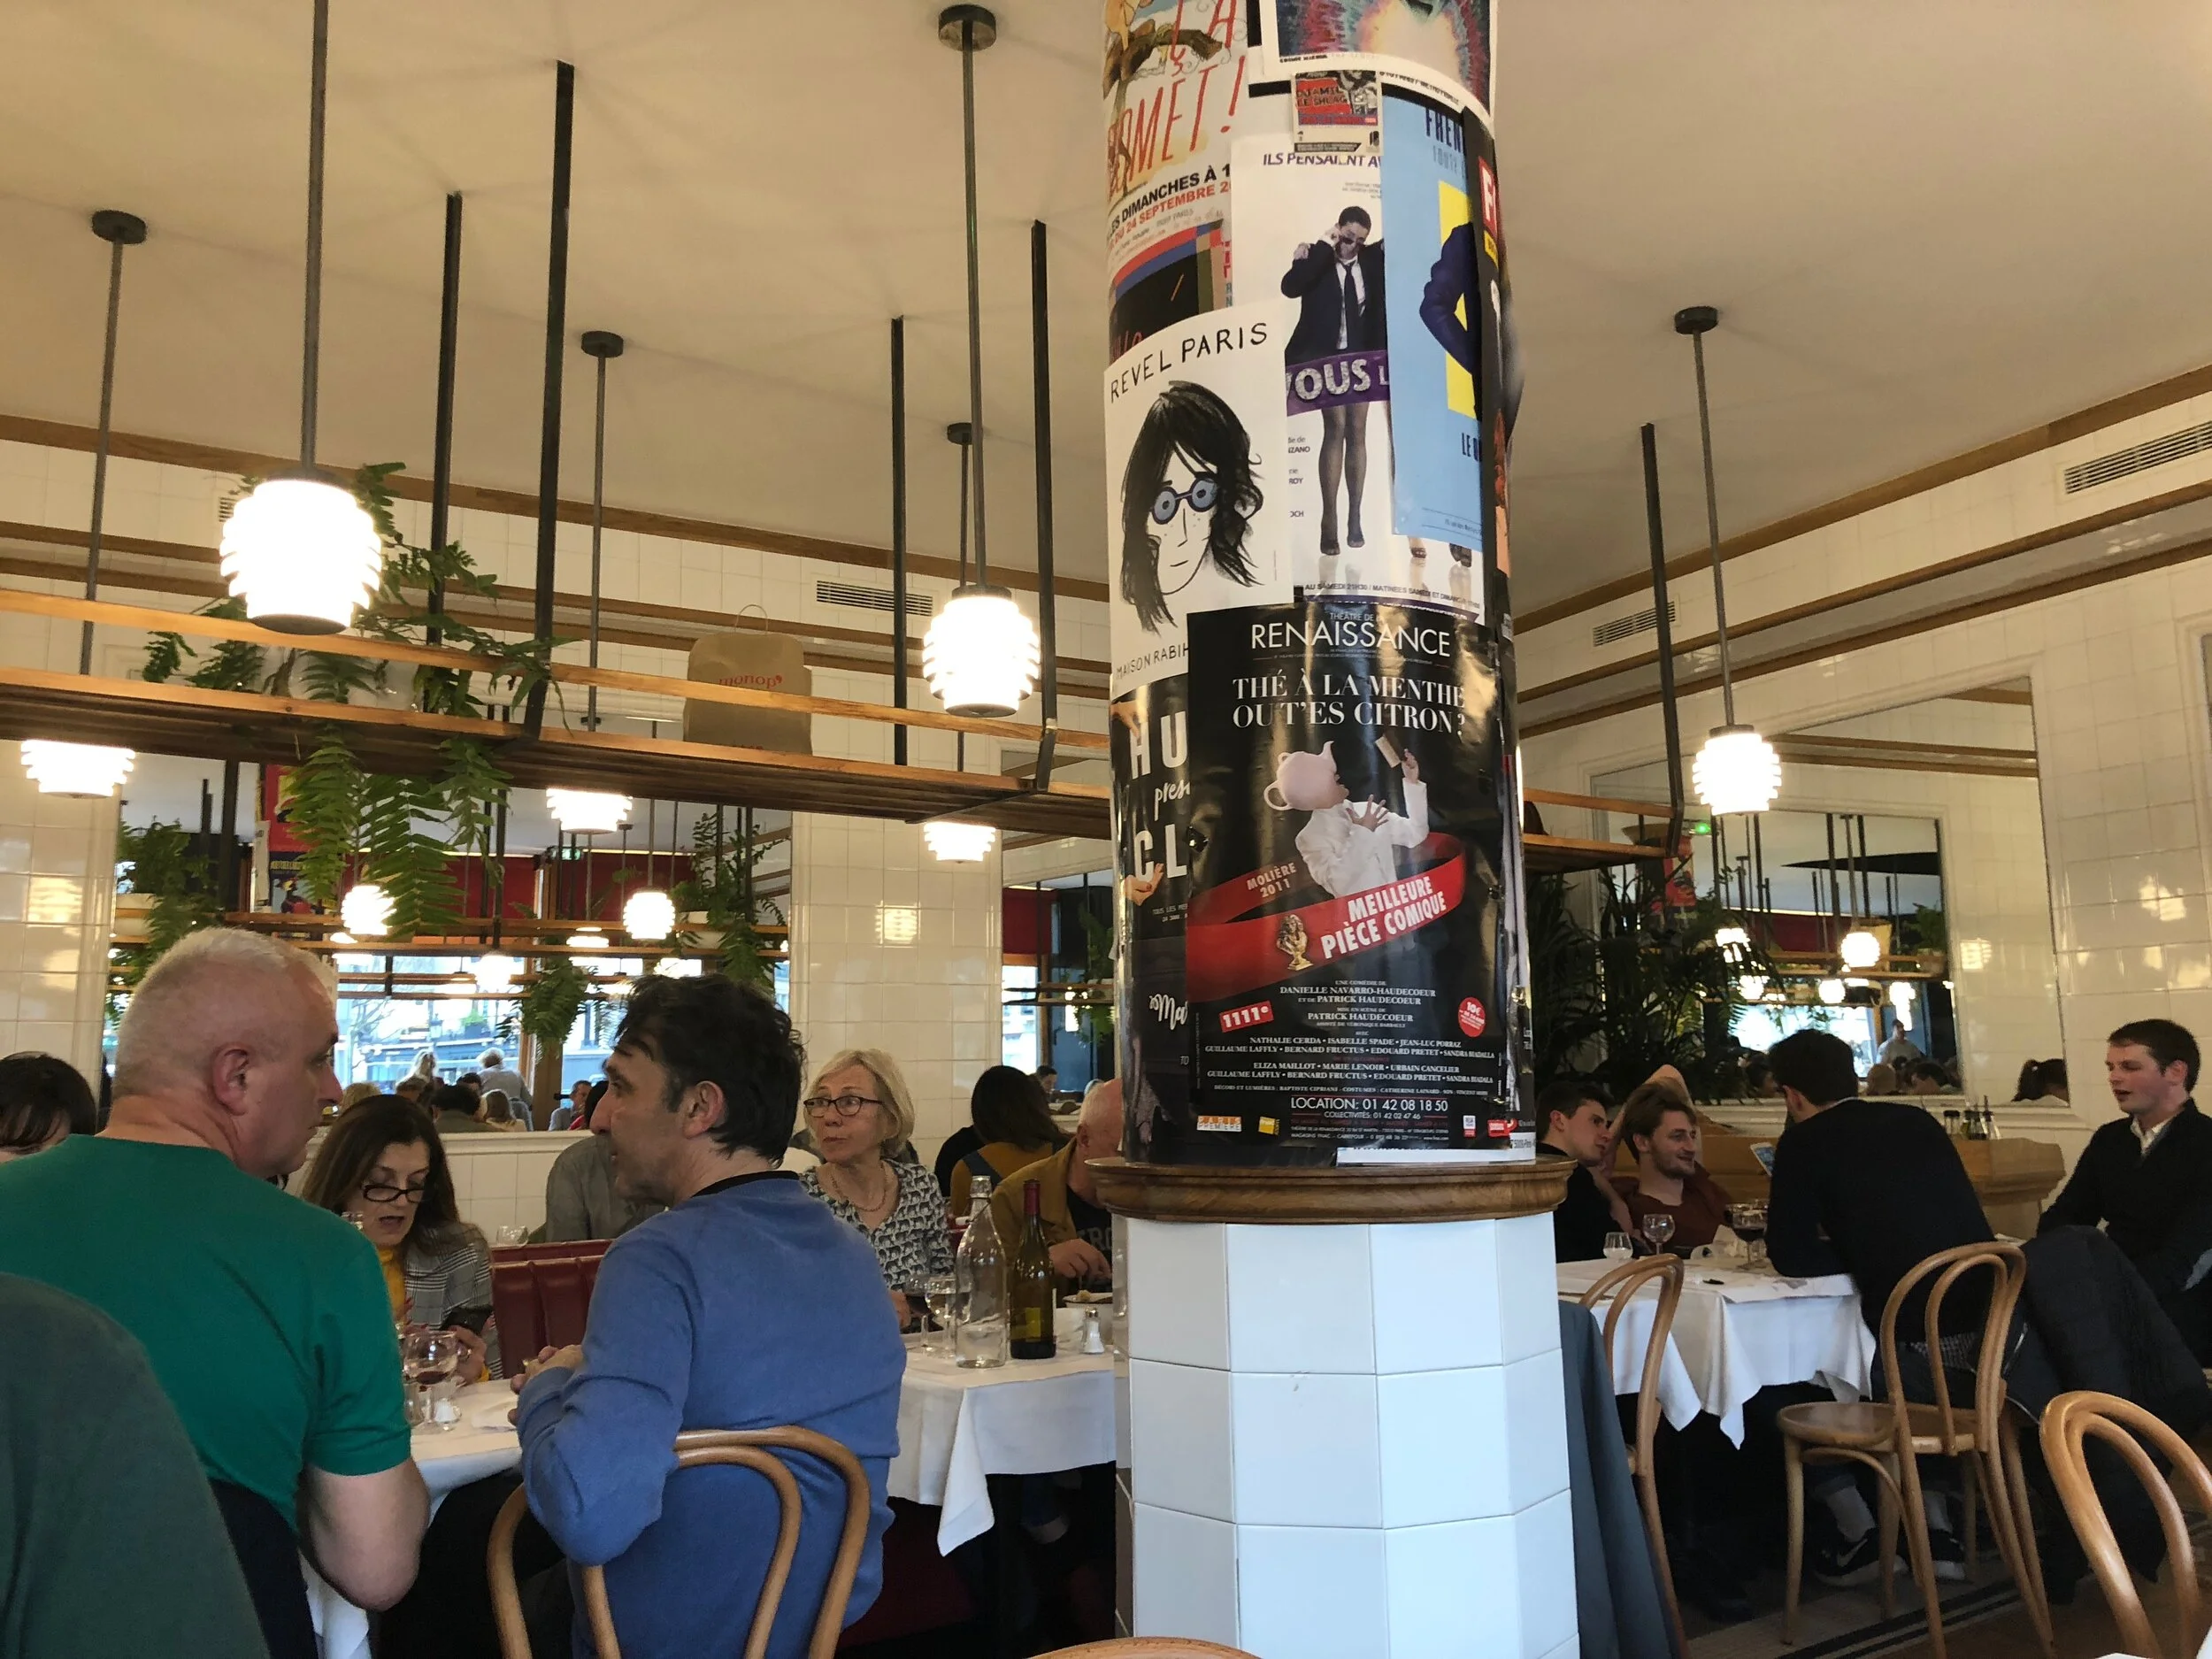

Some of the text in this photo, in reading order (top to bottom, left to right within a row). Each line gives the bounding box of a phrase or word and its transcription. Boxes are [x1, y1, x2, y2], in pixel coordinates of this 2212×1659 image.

[1263, 154, 1283, 166] ILS
[1286, 151, 1356, 167] PENSAINT
[1122, 173, 1200, 223] DIMANCHES
[1204, 164, 1217, 184] À
[1139, 184, 1215, 225] SEPTEMBRE
[1110, 349, 1172, 403] REVEL
[1181, 322, 1267, 364] PARIS
[1317, 582, 1346, 591] SAMEDI
[1409, 588, 1431, 598] SAMEDI
[1432, 591, 1440, 600] ET
[1363, 613, 1374, 622] DE
[1251, 620, 1450, 657] RENAISSANCE
[1116, 653, 1151, 680] MAISON
[1233, 667, 1465, 709] THÉ À LA MENTHE
[1233, 703, 1273, 728] OU
[1354, 702, 1453, 733] CITRON
[1129, 710, 1188, 780] HU
[1134, 824, 1187, 884] CL
[1247, 862, 1297, 891] MOLIÈRE
[1260, 881, 1292, 899] 2011
[1348, 875, 1434, 923] MEILLEURE
[1321, 891, 1448, 960] PIÈCE COMIQUE
[1330, 987, 1436, 997] NAVARRO-HAUDECOEUR
[1358, 995, 1421, 1005] HAUDECOEUR
[1349, 1013, 1413, 1022] HAUDECOEUR
[1328, 1037, 1367, 1046] ISABELLE
[1363, 1098, 1377, 1110] 01
[1382, 1099, 1398, 1110] 42
[1401, 1099, 1416, 1110] 08
[1419, 1100, 1432, 1111] 18
[1434, 1100, 1448, 1111] 50
